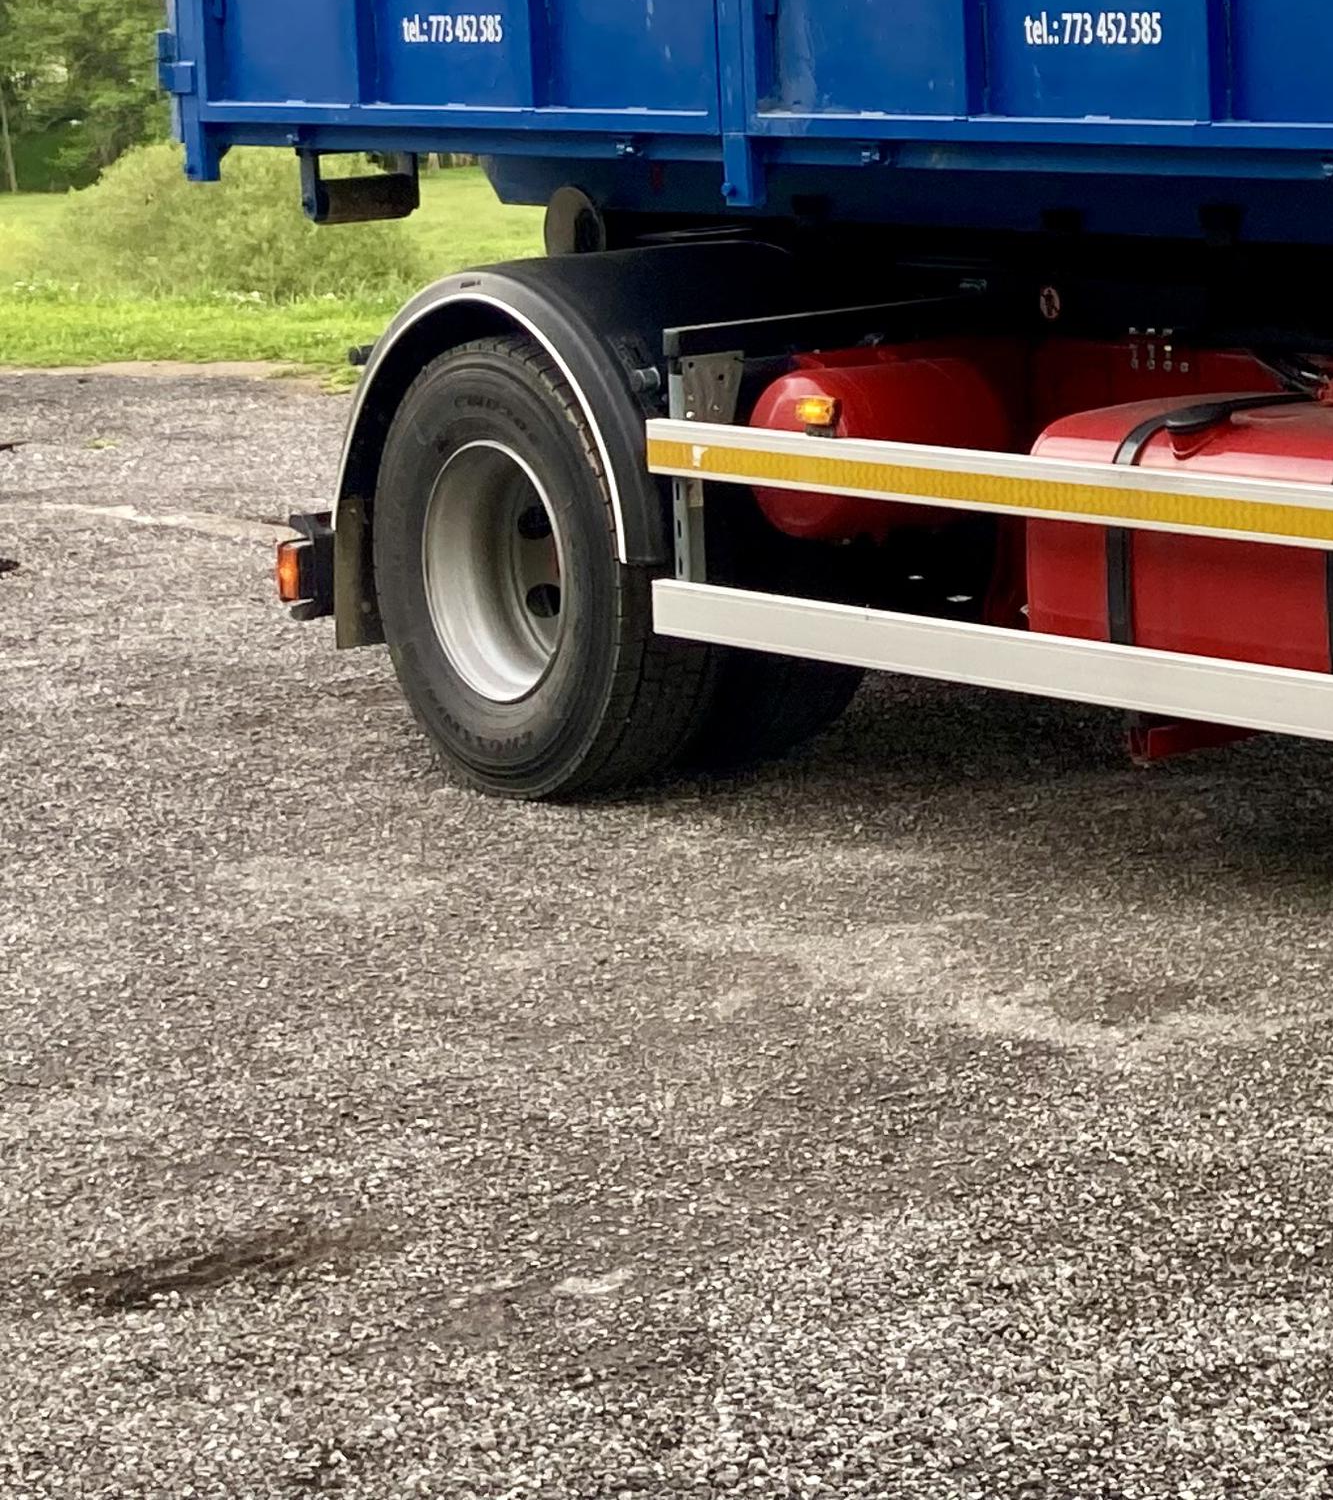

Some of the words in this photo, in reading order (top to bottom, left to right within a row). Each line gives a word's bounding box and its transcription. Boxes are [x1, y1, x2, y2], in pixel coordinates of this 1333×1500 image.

[428, 14, 454, 43] 773
[455, 14, 478, 43] 452
[479, 14, 503, 43] 585
[1024, 11, 1059, 45] tel.:
[1061, 12, 1093, 45] 773
[1096, 12, 1128, 45] 452
[1130, 12, 1162, 45] 585
